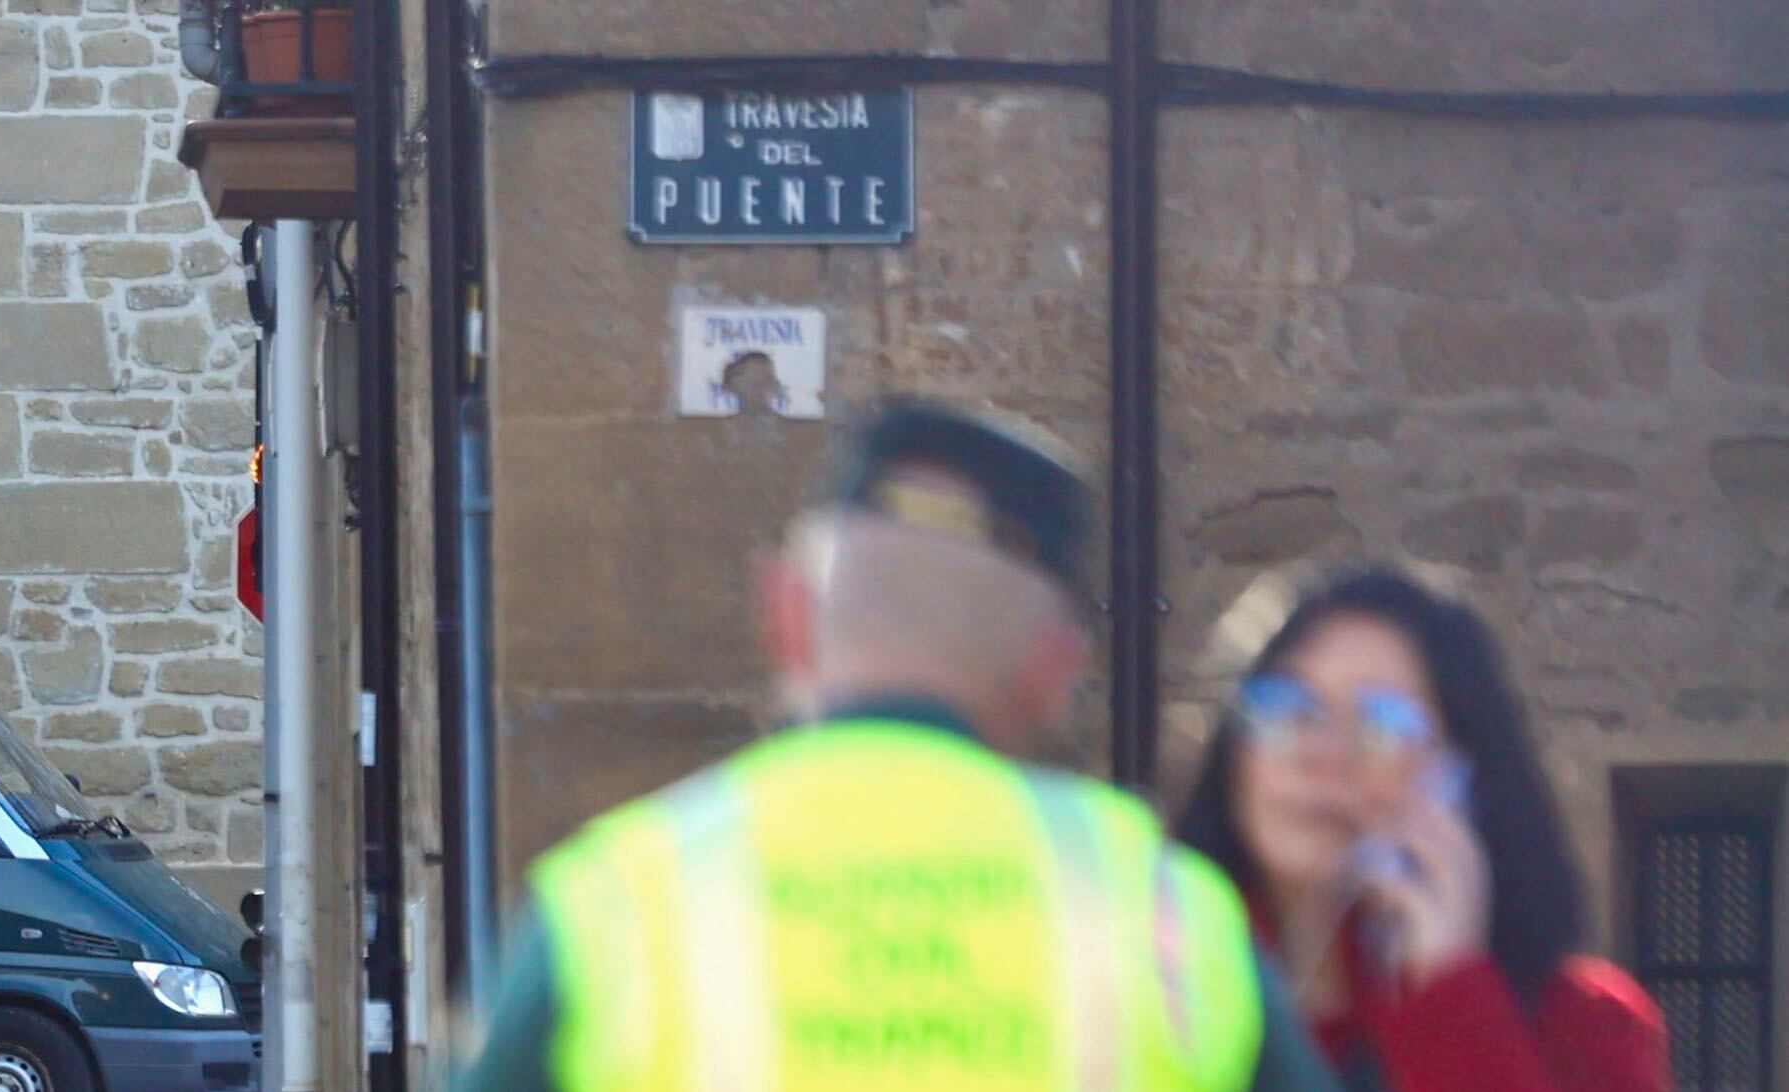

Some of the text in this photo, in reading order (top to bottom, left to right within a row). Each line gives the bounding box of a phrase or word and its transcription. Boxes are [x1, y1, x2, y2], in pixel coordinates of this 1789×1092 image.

[722, 92, 870, 129] TRAVESIA
[758, 140, 823, 166] DEL
[653, 175, 886, 225] PUENTE
